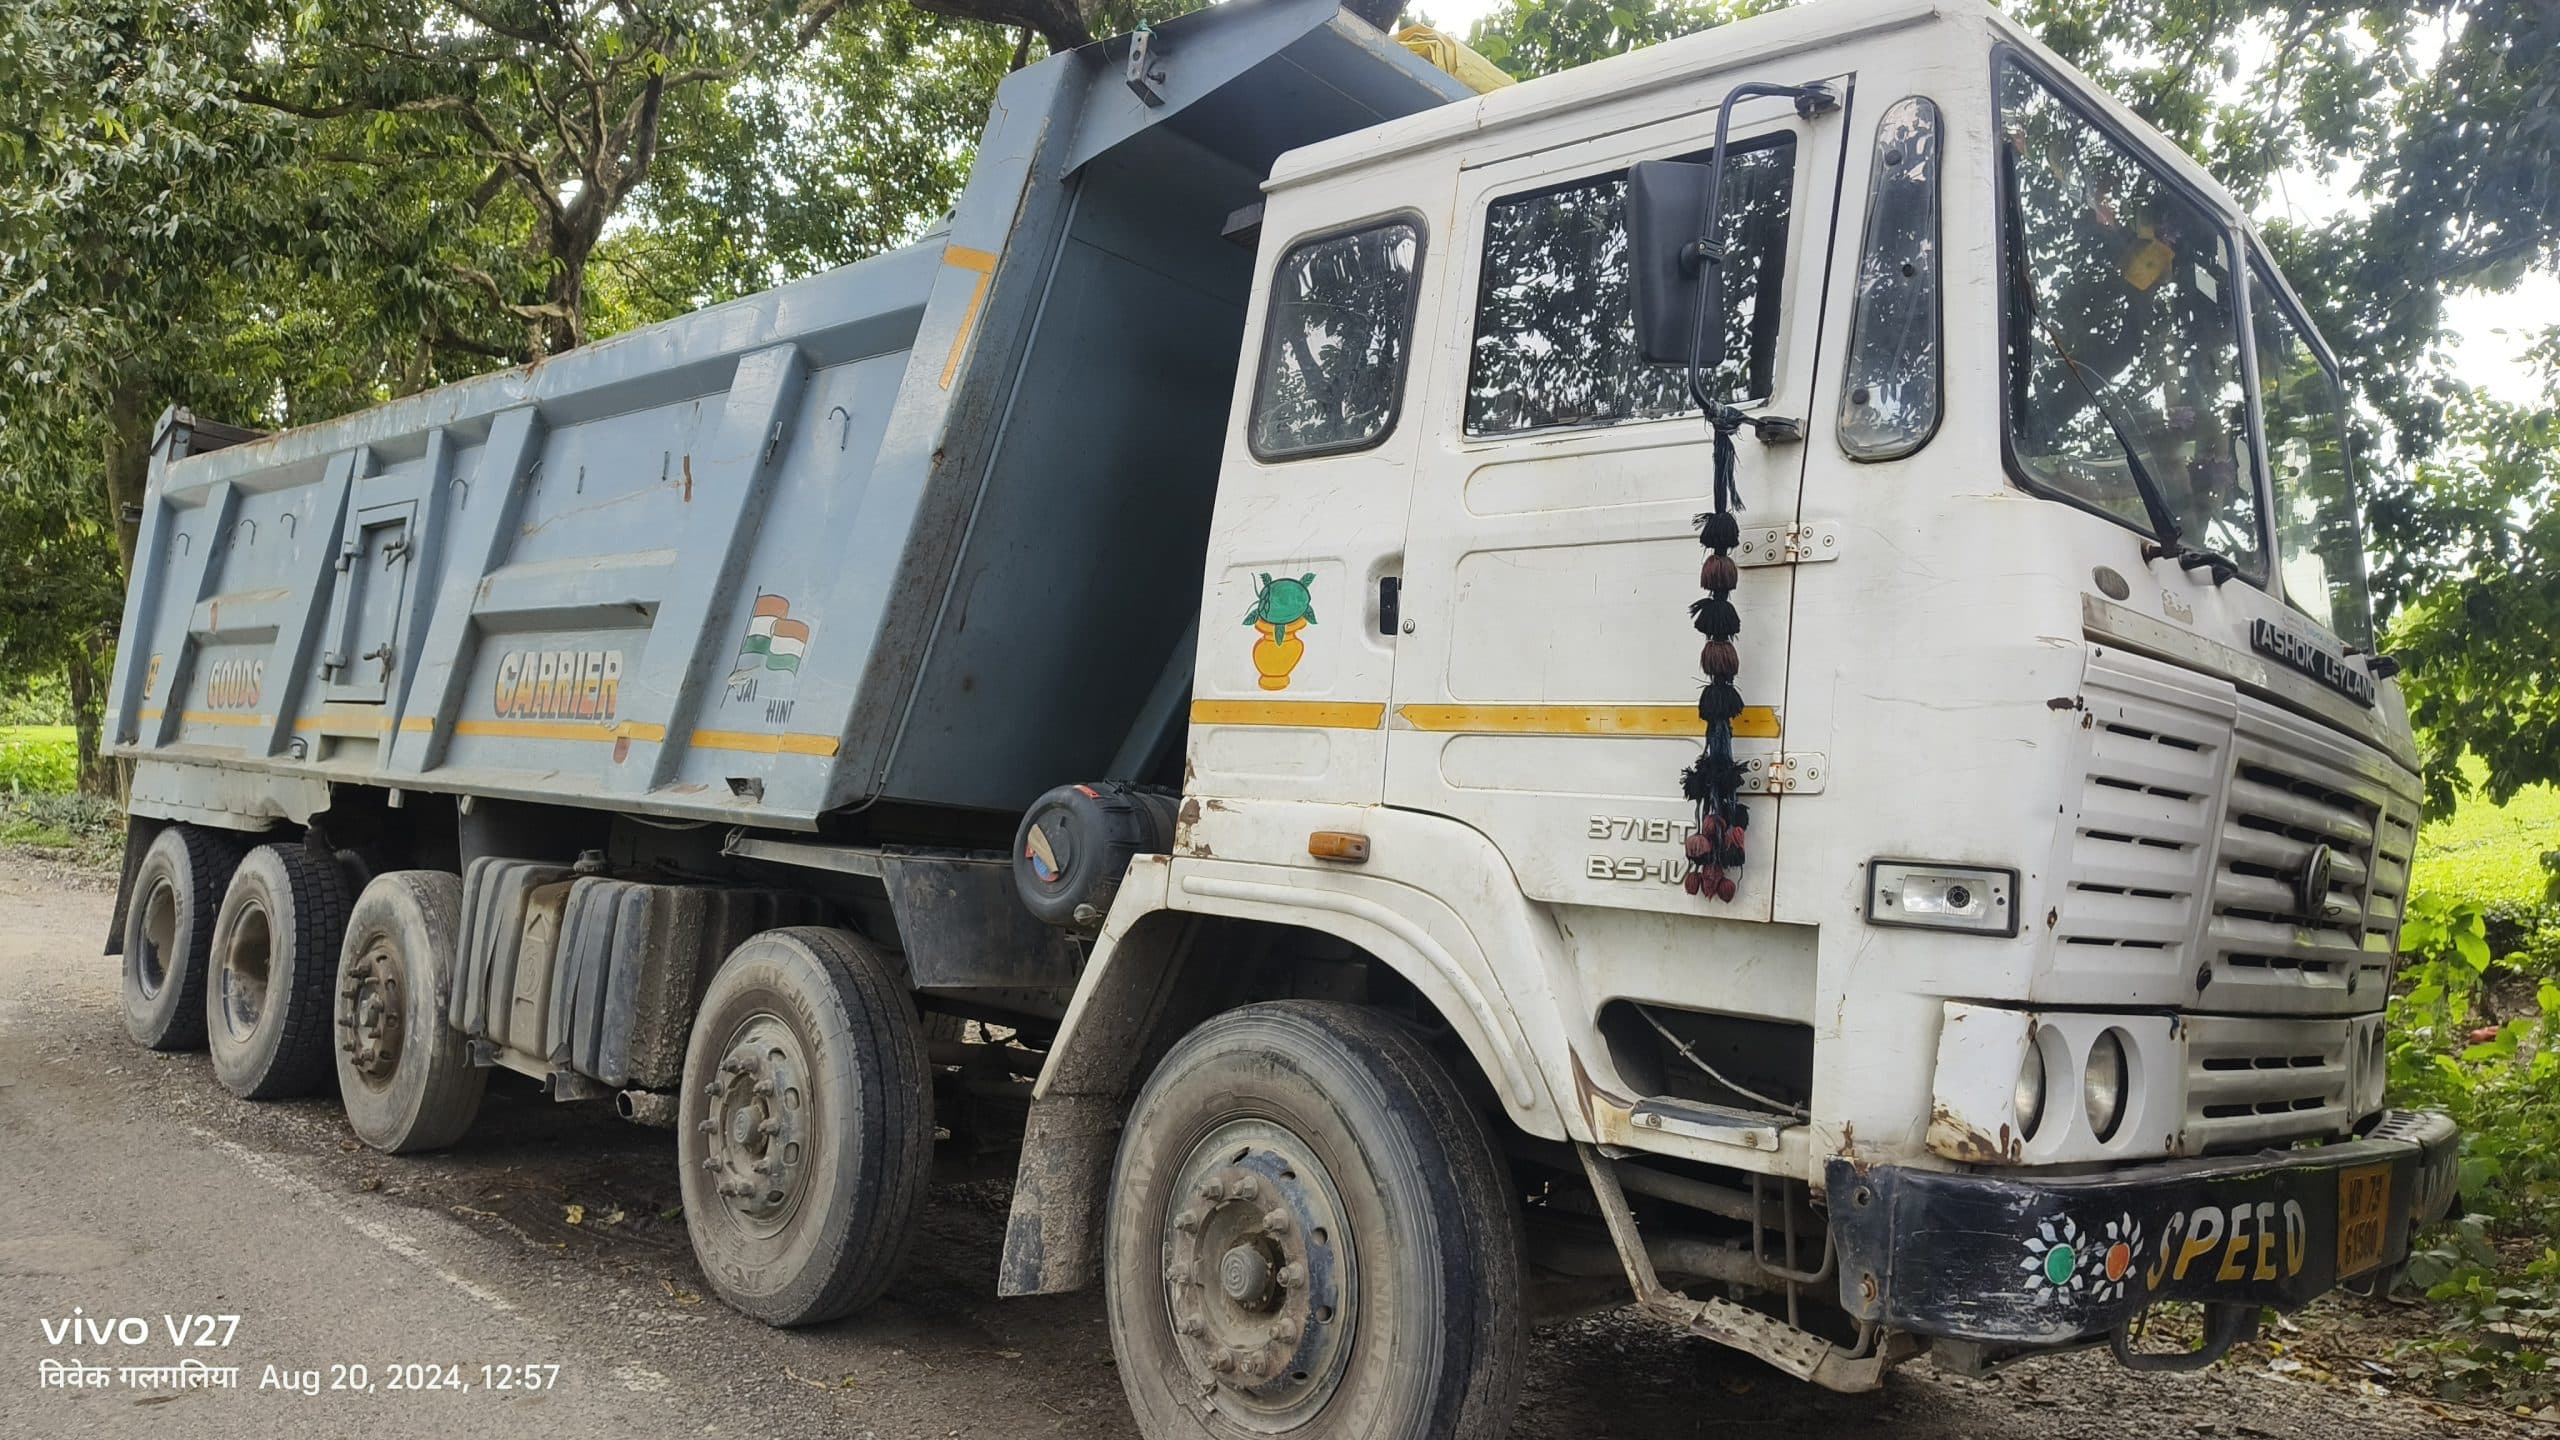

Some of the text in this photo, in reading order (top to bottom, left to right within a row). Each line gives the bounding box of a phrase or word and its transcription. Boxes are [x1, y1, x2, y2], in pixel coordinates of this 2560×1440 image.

[207, 658, 263, 710] GOODS
[494, 649, 624, 720] CARRIER
[736, 678, 759, 703] JAI
[2261, 619, 2376, 705] ASHOK LEYLAND
[1585, 854, 1690, 886] BS-IV
[2146, 1199, 2307, 1292] SPEED
